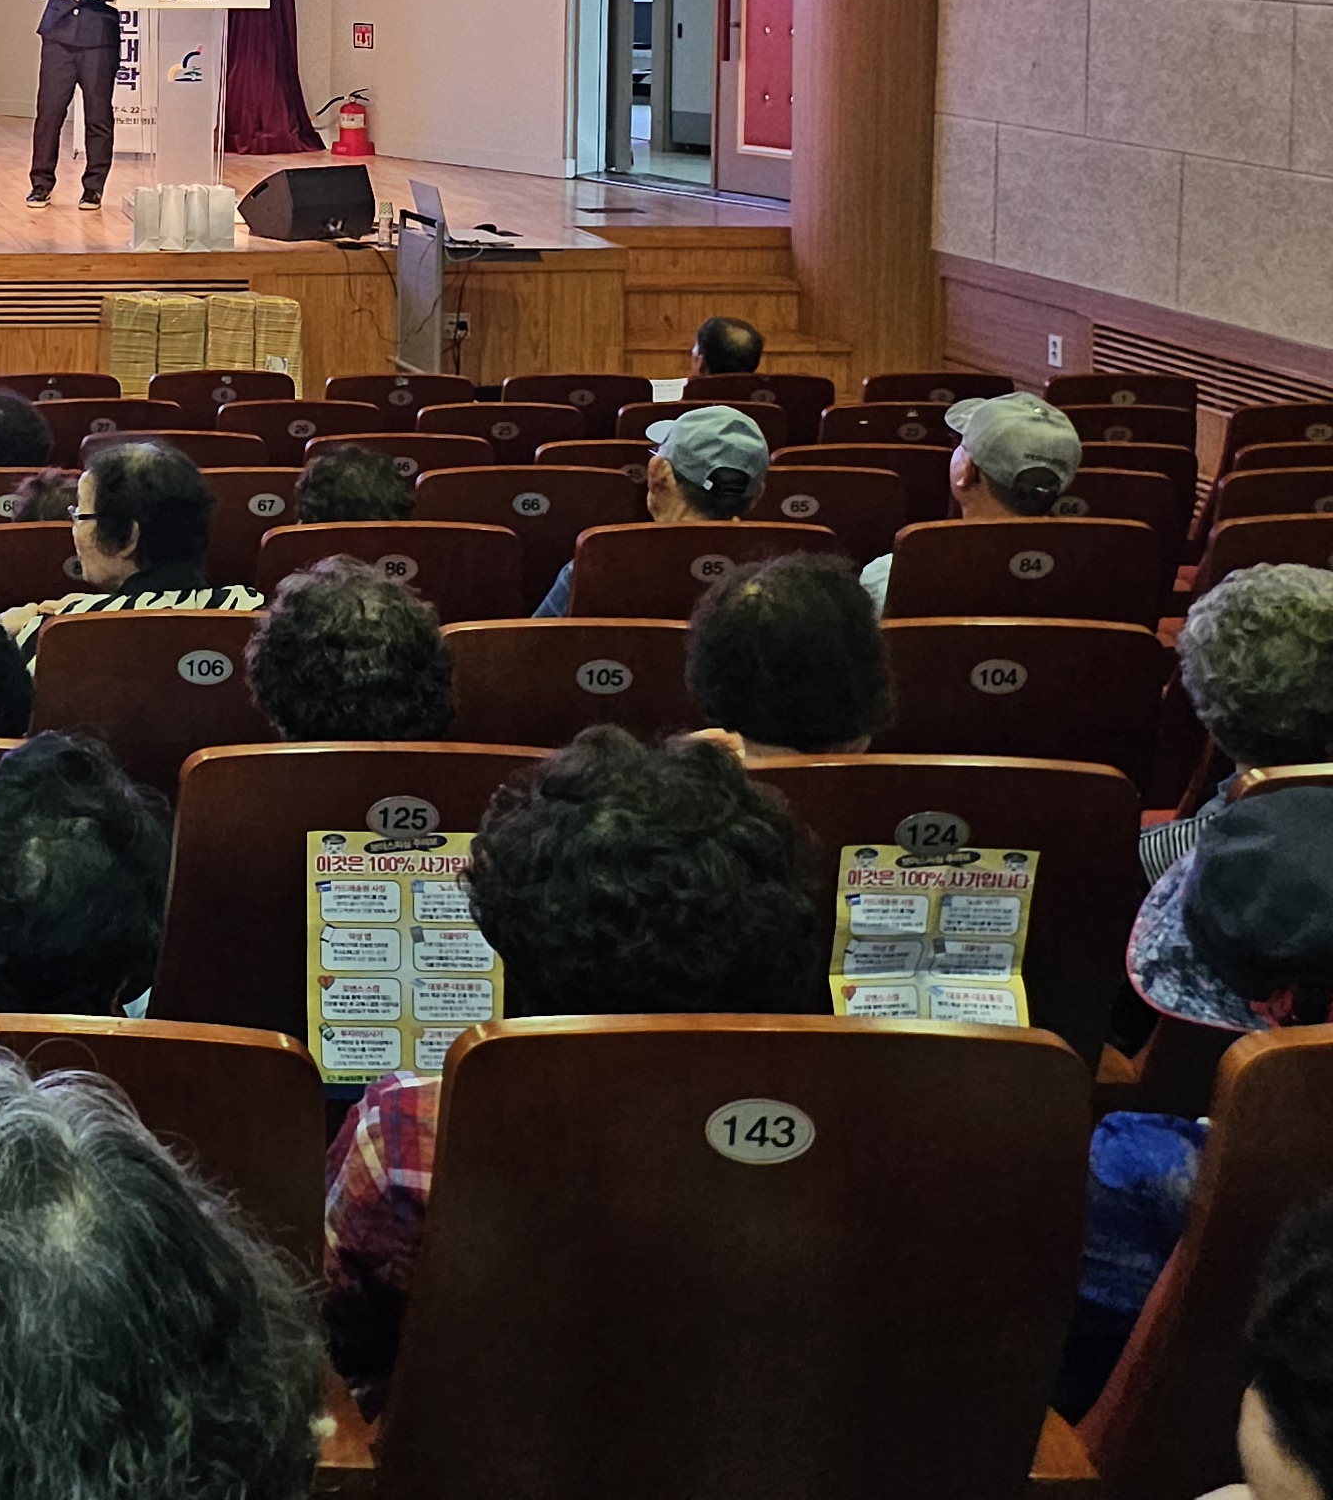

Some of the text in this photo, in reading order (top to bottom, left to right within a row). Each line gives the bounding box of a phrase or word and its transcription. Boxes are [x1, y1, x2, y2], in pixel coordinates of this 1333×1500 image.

[498, 426, 512, 435] 25
[257, 499, 276, 512] 67
[521, 499, 540, 512] 66
[790, 500, 809, 513] 65
[385, 561, 407, 577] 86
[702, 561, 724, 576] 85
[1019, 557, 1042, 572] 84
[186, 659, 225, 677] 106
[585, 668, 624, 687] 105
[978, 668, 1018, 687] 104
[378, 806, 429, 831] 125
[906, 823, 959, 847] 124
[316, 856, 472, 873] 이것은 100% 사기입
[848, 870, 1030, 889] 이것은 100% 사기입니다
[723, 1115, 796, 1148] 143
